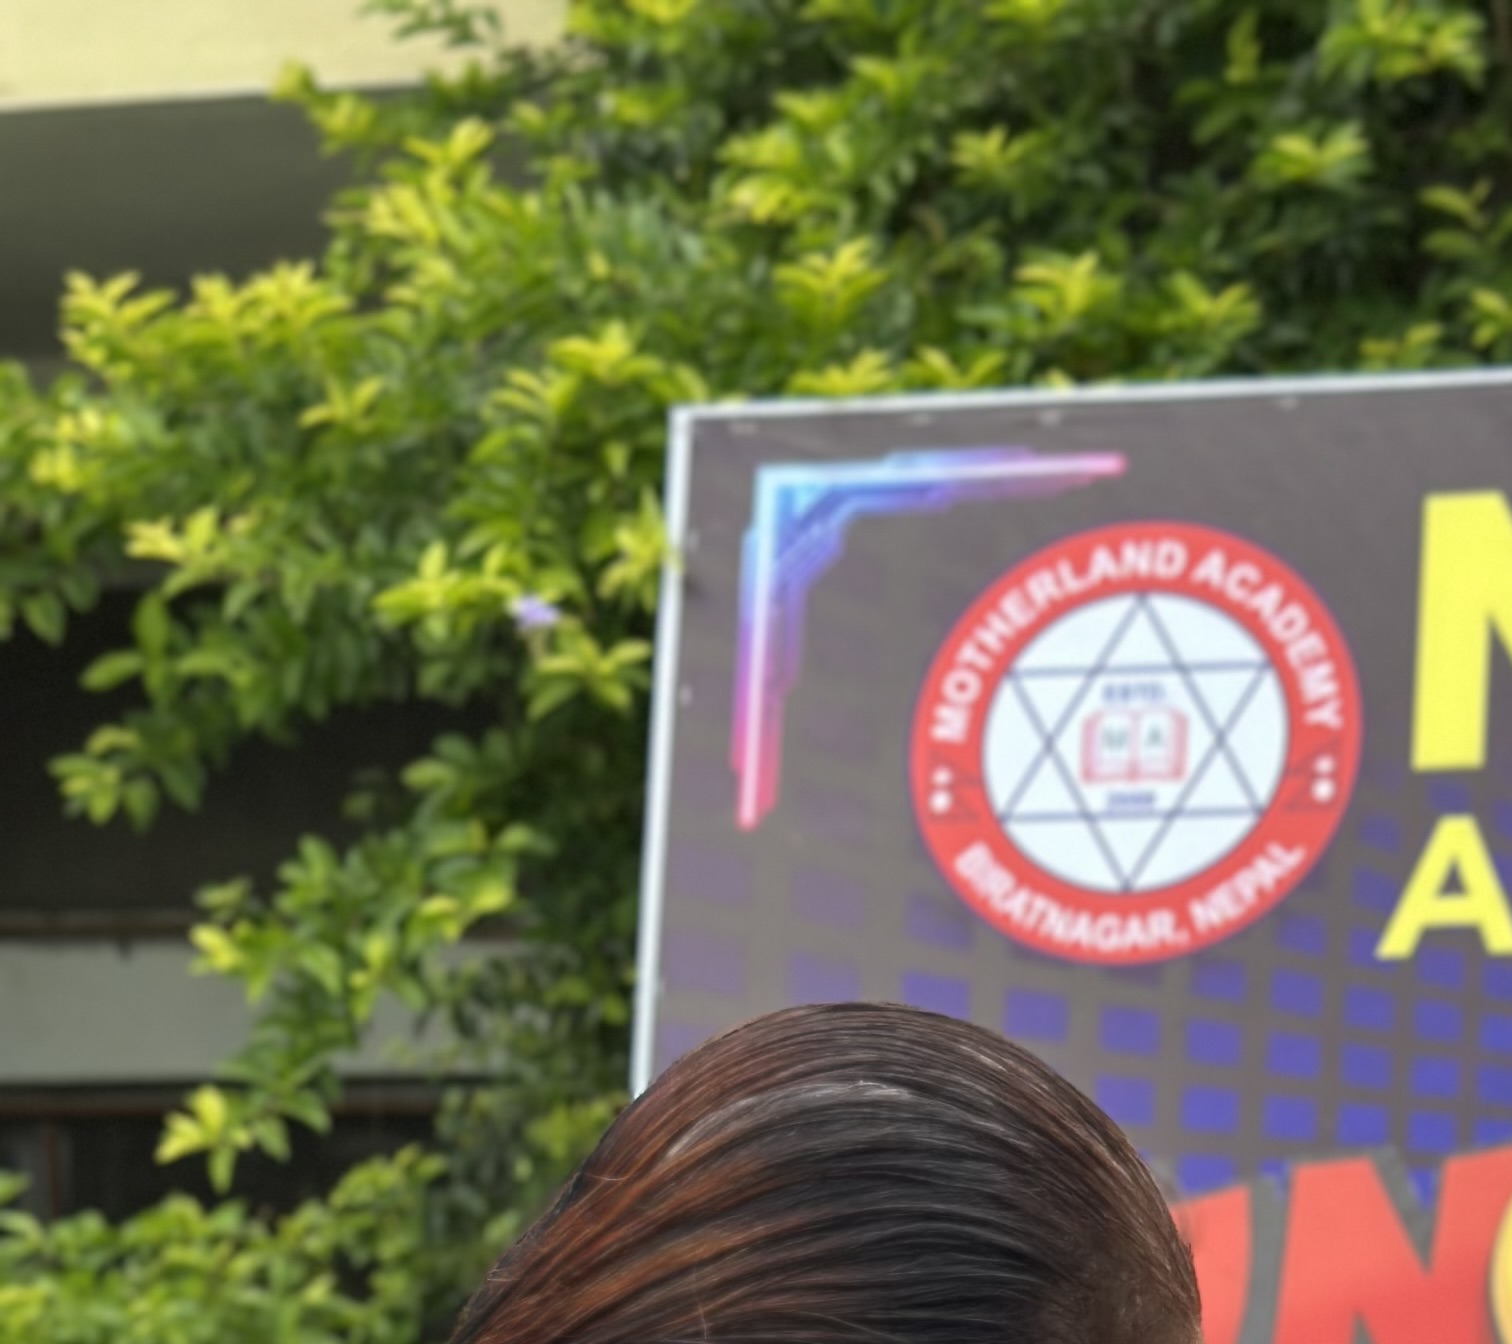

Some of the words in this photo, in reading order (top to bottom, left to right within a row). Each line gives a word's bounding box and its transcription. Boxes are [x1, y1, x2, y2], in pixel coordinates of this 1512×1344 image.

[931, 539, 1188, 743] MOTHERLAND
[1192, 550, 1344, 731] ACADEMY
[1188, 842, 1305, 932] NEPAL
